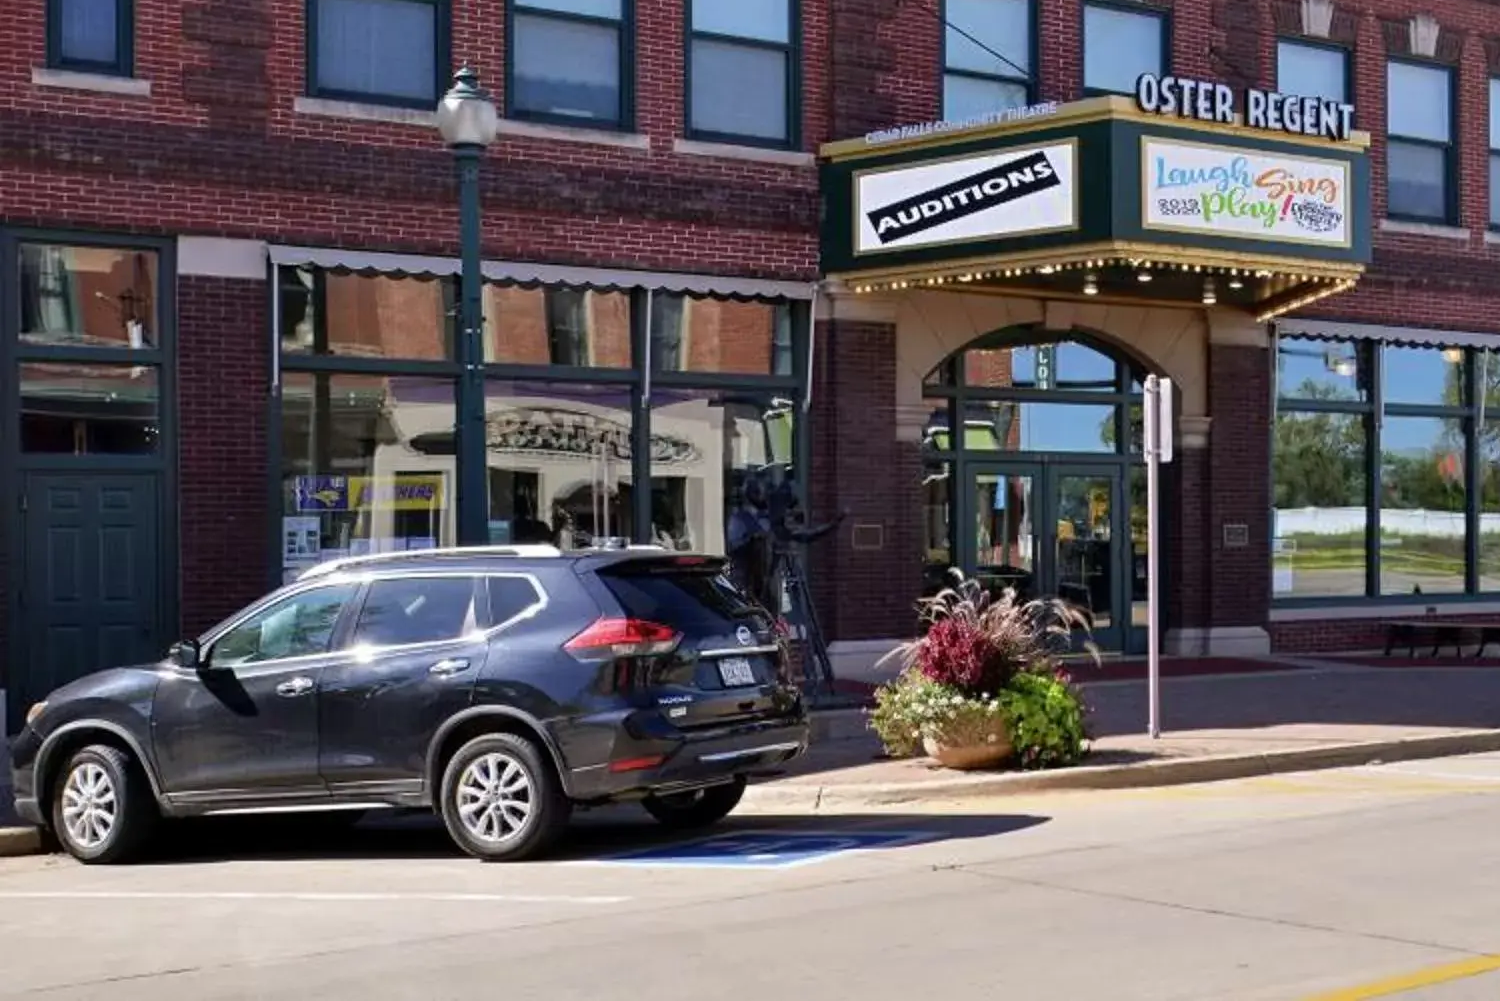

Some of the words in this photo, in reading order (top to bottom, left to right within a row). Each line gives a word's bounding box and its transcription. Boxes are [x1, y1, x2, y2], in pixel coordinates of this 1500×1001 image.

[1006, 101, 1057, 120] THEATRE
[1137, 72, 1234, 124] OSTER
[1248, 88, 1355, 140] REGENT
[876, 160, 1054, 234] AUDITIONS
[1156, 155, 1252, 192] Laugh
[1254, 167, 1338, 203] Sing
